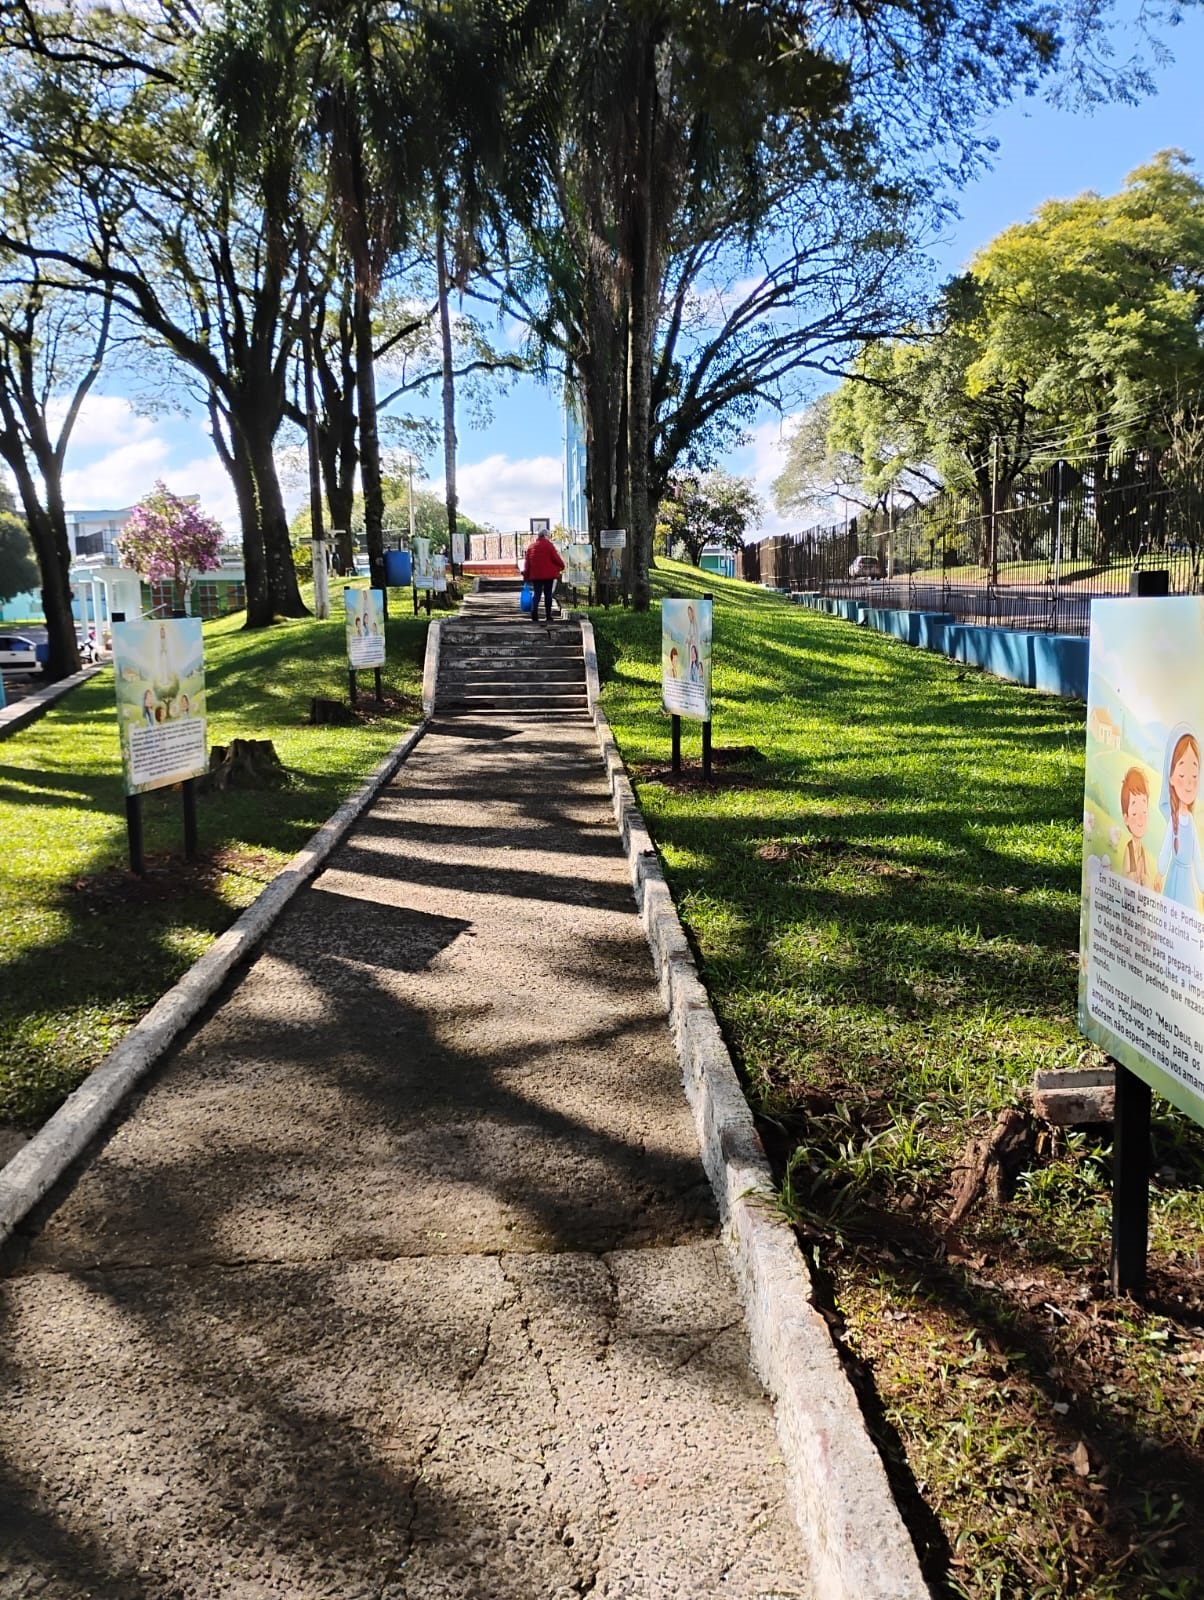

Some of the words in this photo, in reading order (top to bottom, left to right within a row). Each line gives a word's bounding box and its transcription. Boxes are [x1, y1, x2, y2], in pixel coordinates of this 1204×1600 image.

[1095, 900, 1112, 916] quando
[1113, 910, 1120, 921] um
[1121, 911, 1134, 928] lindo
[1135, 921, 1146, 936] anjo
[1137, 906, 1162, 927] Francisco
[1164, 921, 1167, 930] e
[1168, 921, 1189, 941] Jacinta
[1138, 890, 1167, 914] lugarzinho
[1171, 904, 1178, 919] de
[1093, 942, 1115, 961] apareceu
[1117, 955, 1126, 968] três
[1128, 962, 1144, 980] vezes,
[1146, 973, 1169, 994] pedindo
[1171, 988, 1182, 1002] que
[1094, 928, 1107, 941] muito
[1110, 937, 1132, 957] especial,
[1135, 952, 1178, 984] ensinando-lhes
[1181, 979, 1185, 988] a
[1098, 914, 1102, 925] O
[1104, 917, 1114, 932] Anjo
[1124, 928, 1133, 943] Paz
[1135, 937, 1151, 953] surgiu
[1153, 942, 1166, 960] para
[1168, 955, 1202, 981] prepará-las
[1092, 988, 1115, 1011] amo-vos.
[1118, 1004, 1144, 1031] Peço-vos
[1147, 1026, 1170, 1049] perdão
[1173, 1045, 1189, 1063] para
[1192, 1058, 1200, 1071] os
[1096, 972, 1114, 994] Vamos
[1115, 988, 1129, 1004] rezar
[1130, 995, 1153, 1020] juntos?
[1174, 1024, 1193, 1049] Deus,
[1194, 1040, 1204, 1054] eu
[1091, 1003, 1114, 1027] adoram,
[1114, 1019, 1124, 1034] não
[1125, 1028, 1151, 1054] esperam
[1152, 1047, 1156, 1057] e
[1157, 1050, 1169, 1067] não
[1170, 1060, 1182, 1076] vos
[1182, 1069, 1204, 1094] amam
